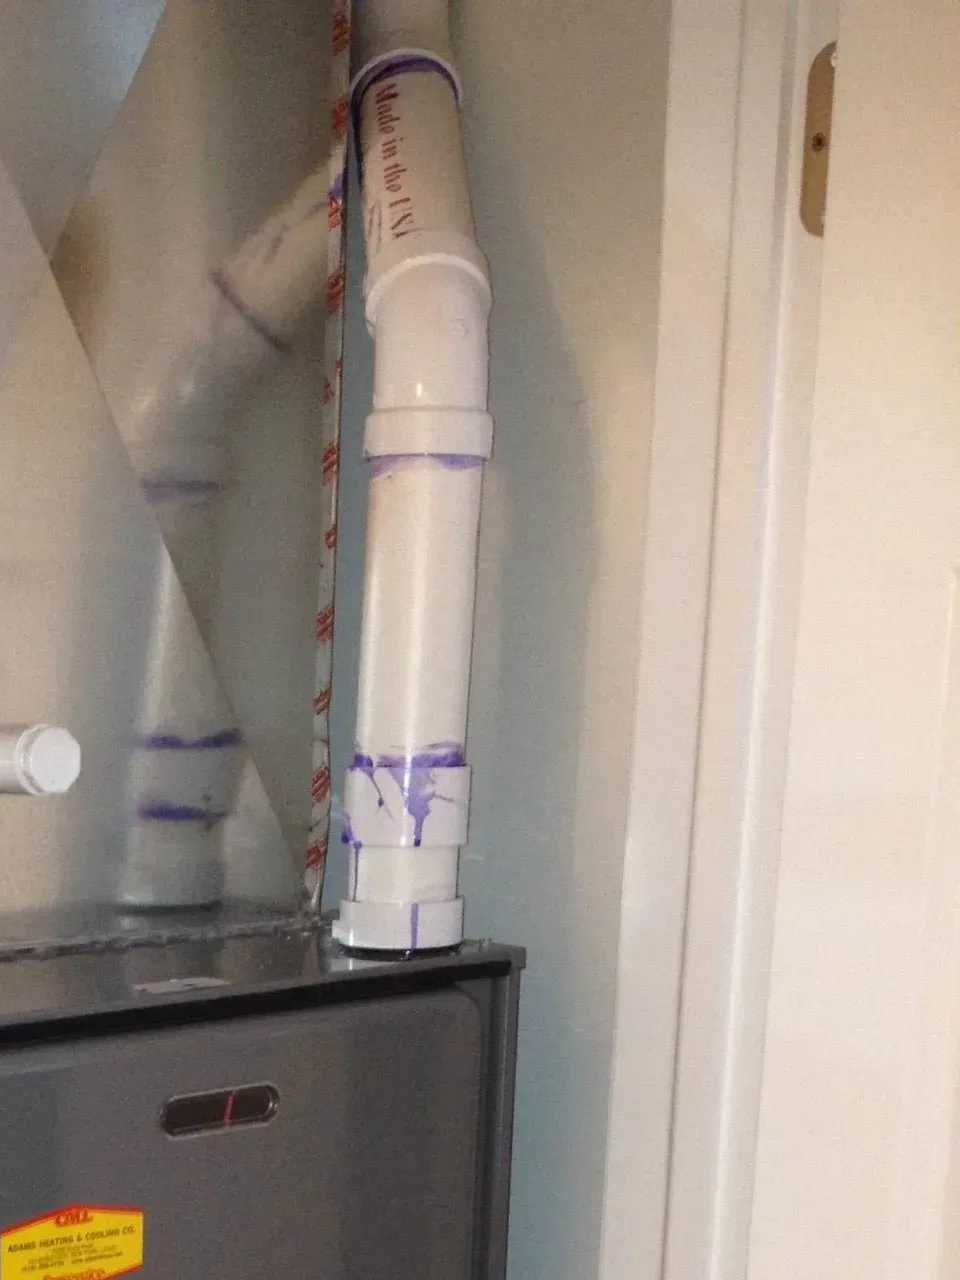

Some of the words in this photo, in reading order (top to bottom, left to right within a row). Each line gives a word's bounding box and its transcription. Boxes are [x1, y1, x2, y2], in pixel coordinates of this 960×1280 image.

[376, 83, 401, 134] Made
[382, 136, 405, 161] in
[383, 162, 408, 193] the
[7, 1241, 37, 1254] ADAMS
[39, 1234, 75, 1249] HEATING
[85, 1226, 121, 1241] COOLING
